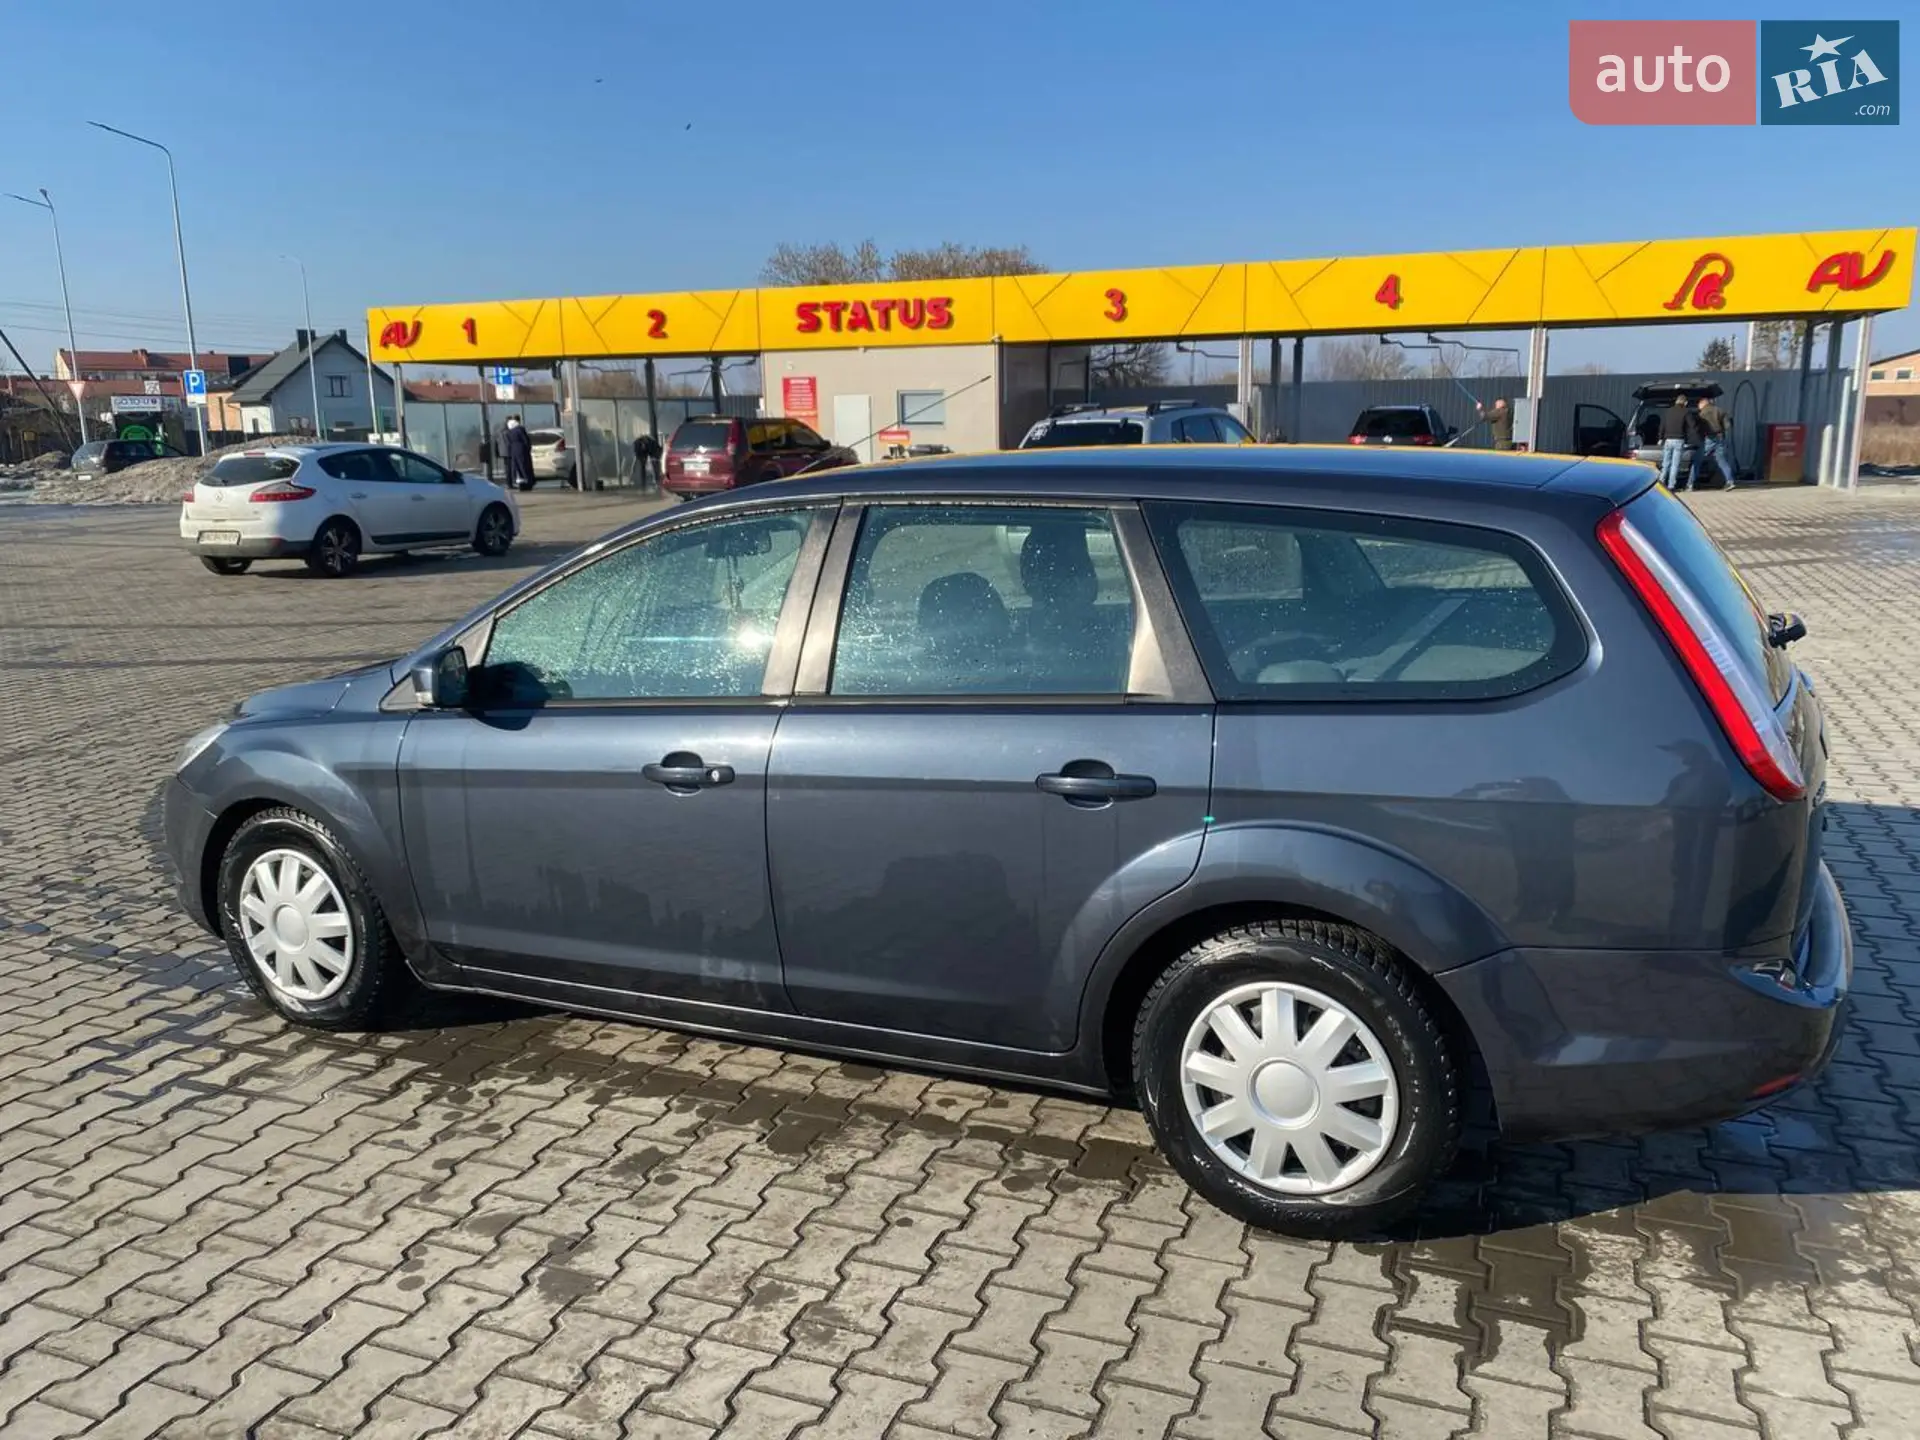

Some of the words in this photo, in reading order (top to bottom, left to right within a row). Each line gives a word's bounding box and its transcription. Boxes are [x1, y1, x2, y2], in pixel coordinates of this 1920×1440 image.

[1106, 288, 1127, 322] 3
[1375, 275, 1403, 310] 4
[648, 309, 666, 338] 2
[796, 297, 953, 333] STATUS
[461, 317, 477, 345] 1
[189, 373, 201, 392] P
[499, 367, 510, 384] P
